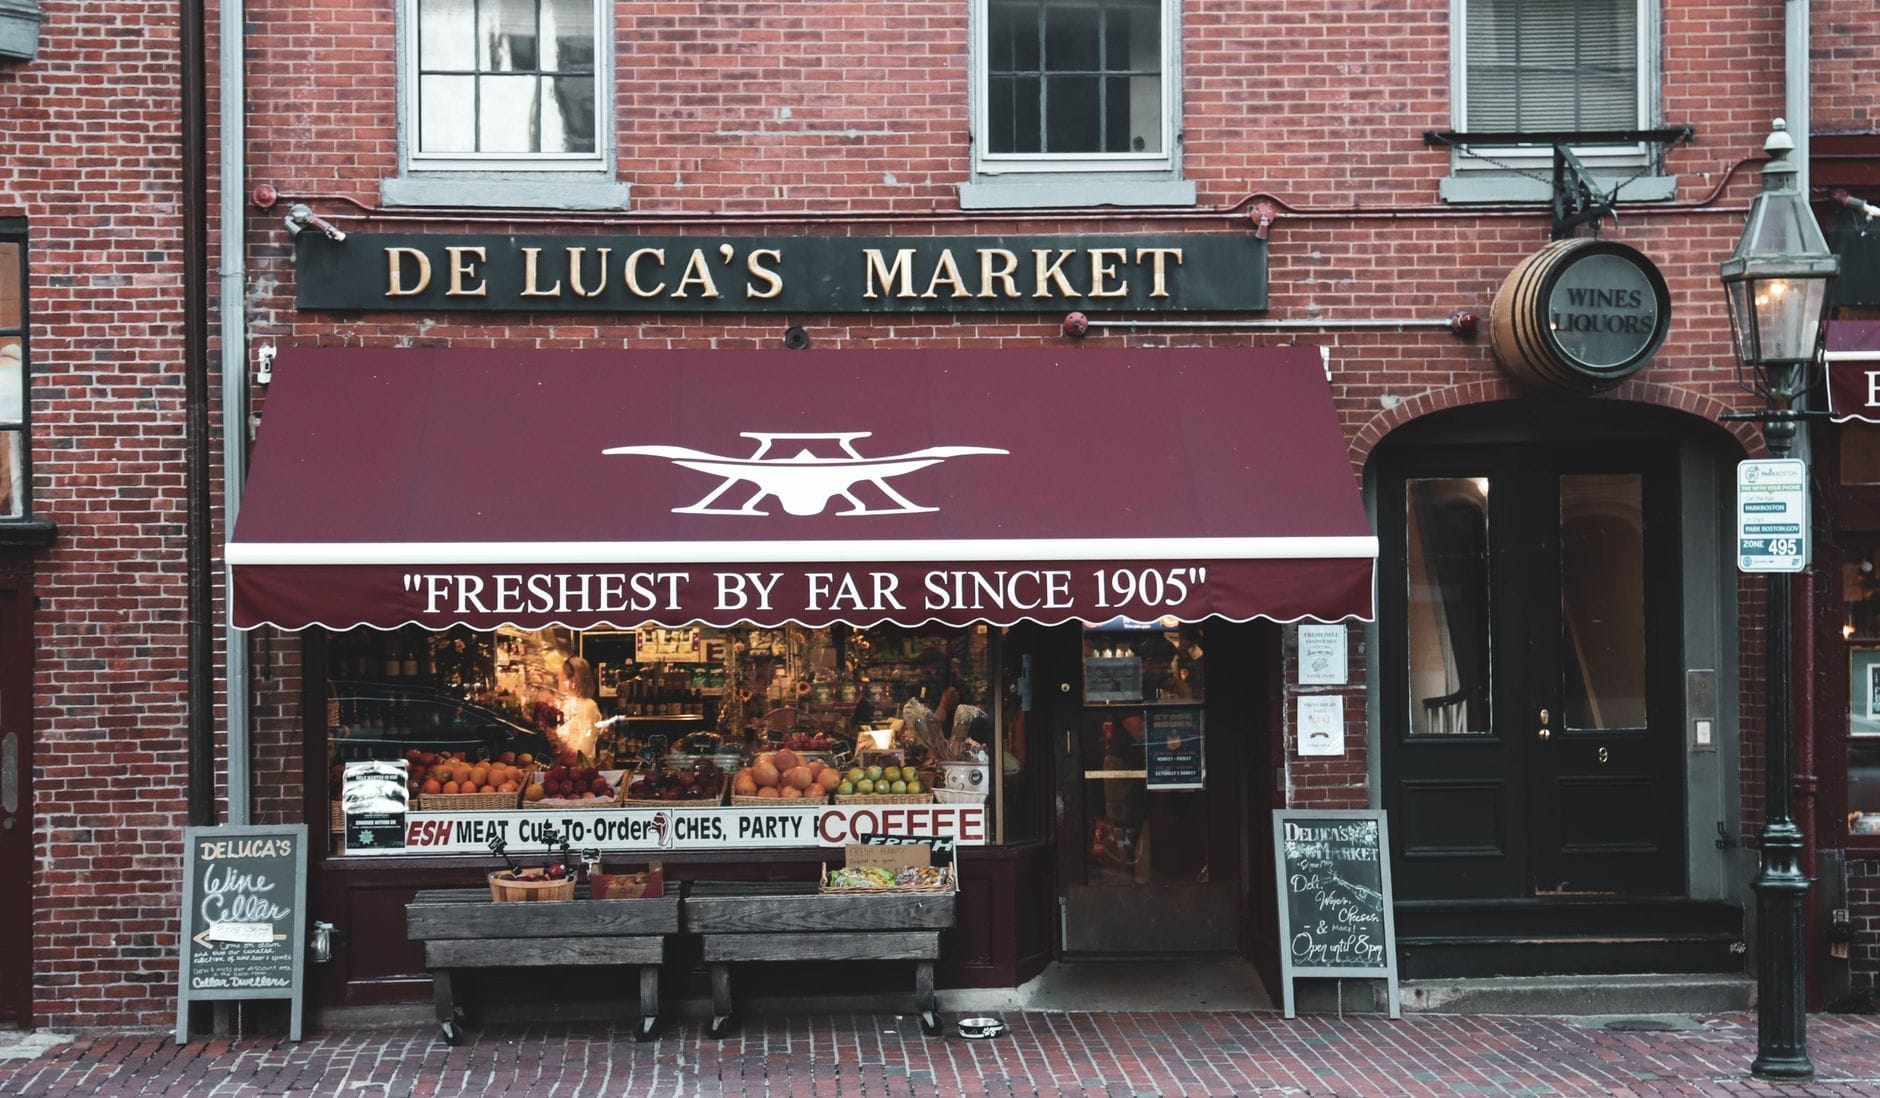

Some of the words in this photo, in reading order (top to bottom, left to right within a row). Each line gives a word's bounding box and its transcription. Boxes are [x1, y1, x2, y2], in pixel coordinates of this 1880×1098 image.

[384, 245, 487, 297] DE
[520, 243, 784, 299] LUCA'S
[862, 247, 1183, 299] MARKET
[1566, 288, 1642, 308] WINES
[1553, 313, 1653, 334] LIQUORS
[1743, 540, 1764, 548] ZONE
[1768, 539, 1797, 555] 495
[403, 572, 690, 614] "FRESHEST
[712, 572, 785, 611] BY
[804, 571, 906, 611] FAR
[924, 569, 1075, 611] SINCE
[1093, 567, 1207, 608] 1905"
[1599, 747, 1608, 762] 9
[405, 820, 453, 846] ESH
[456, 819, 509, 843] MEAT
[738, 815, 803, 839] PARTY
[819, 808, 984, 843] COFFEE
[200, 839, 292, 860] DELUCA'S
[203, 863, 275, 894] Wine
[201, 893, 291, 924] Cellar
[1316, 920, 1329, 934] &
[1292, 932, 1328, 963] Open
[1329, 935, 1356, 963] until
[1354, 934, 1383, 961] 8pm
